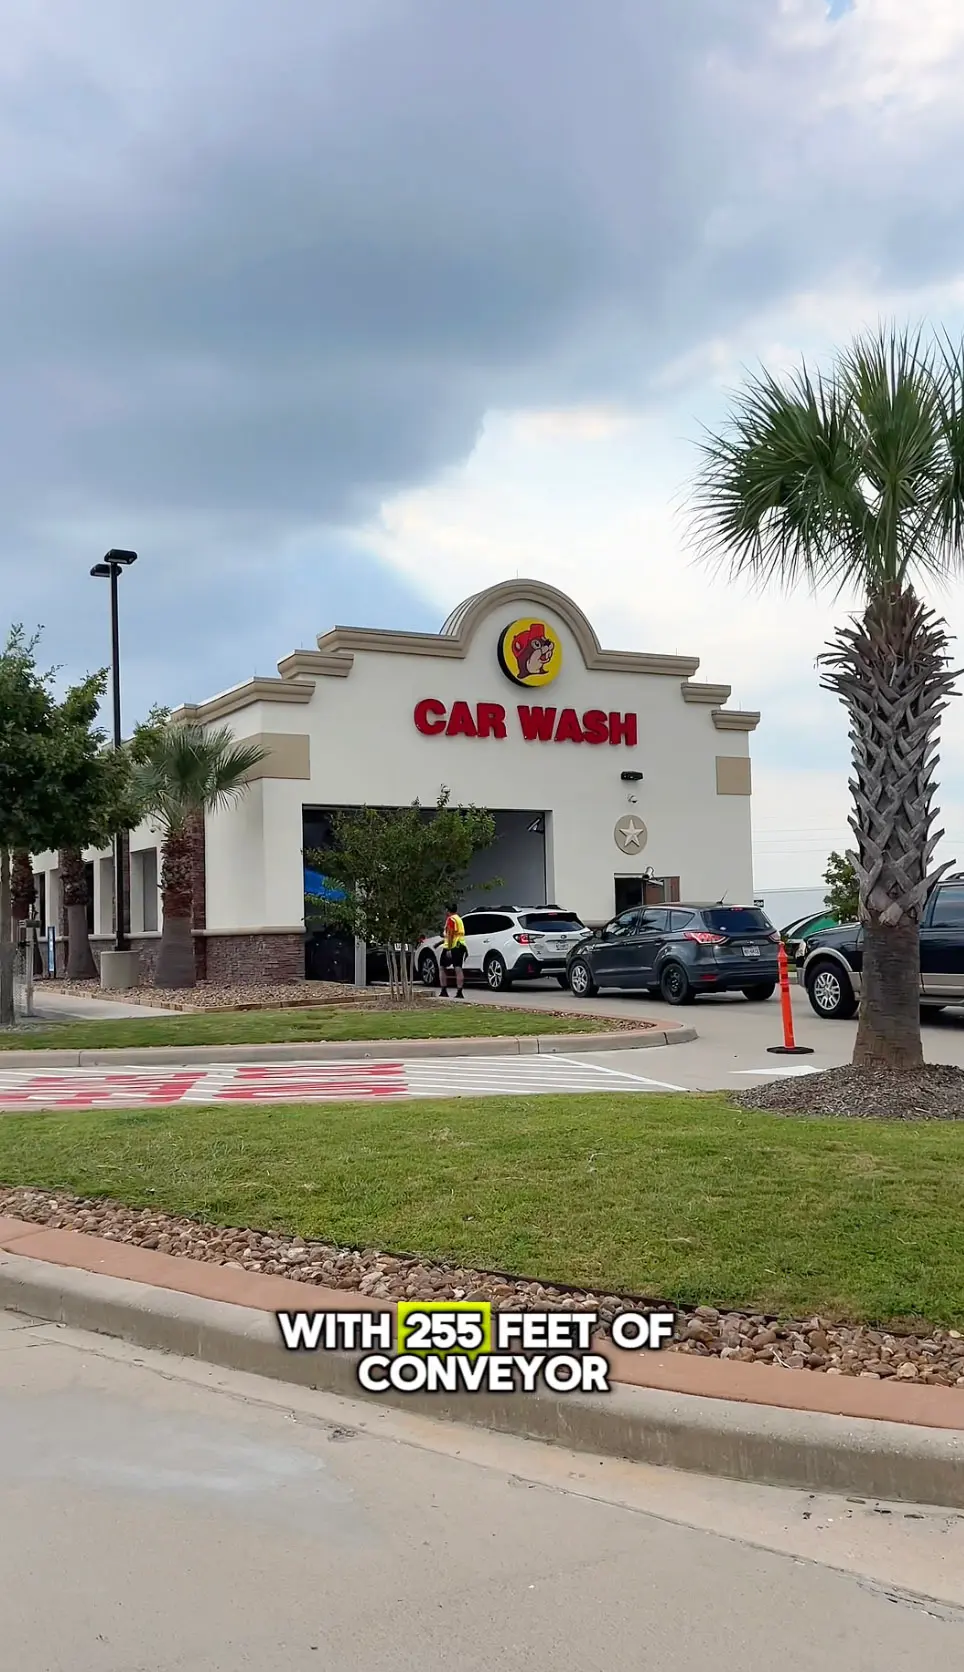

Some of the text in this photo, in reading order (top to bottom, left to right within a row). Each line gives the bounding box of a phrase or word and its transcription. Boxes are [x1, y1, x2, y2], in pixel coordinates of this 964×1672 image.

[414, 699, 637, 746] CAR WASH
[211, 1080, 412, 1099] NO
